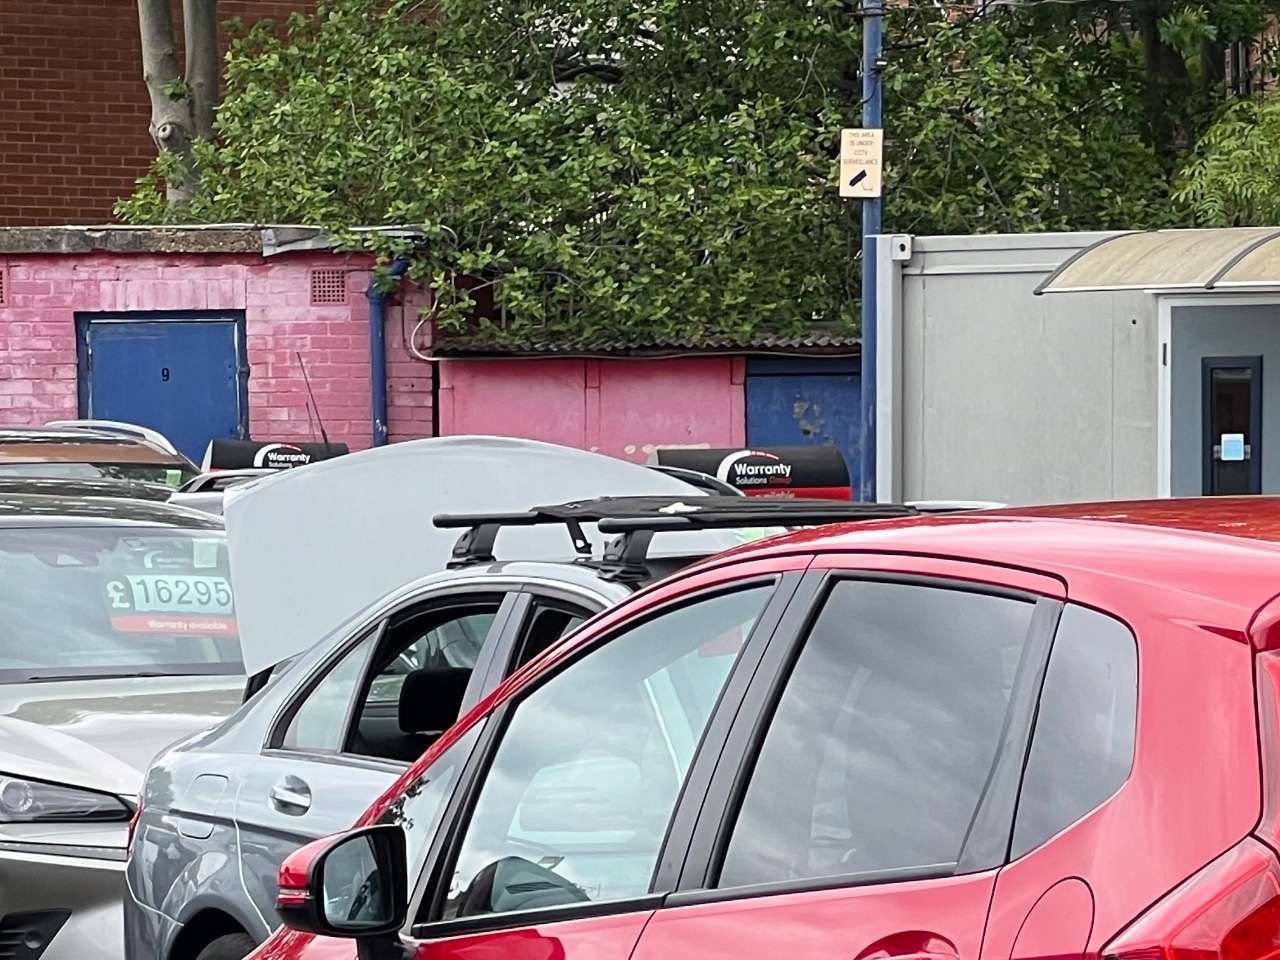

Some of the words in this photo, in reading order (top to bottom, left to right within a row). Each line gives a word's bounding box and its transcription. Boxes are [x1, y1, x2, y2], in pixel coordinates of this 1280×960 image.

[161, 367, 170, 382] 9
[267, 452, 311, 464] Warranty
[734, 463, 792, 477] Warranty
[735, 476, 768, 485] Solutions
[106, 579, 231, 609] £16295
